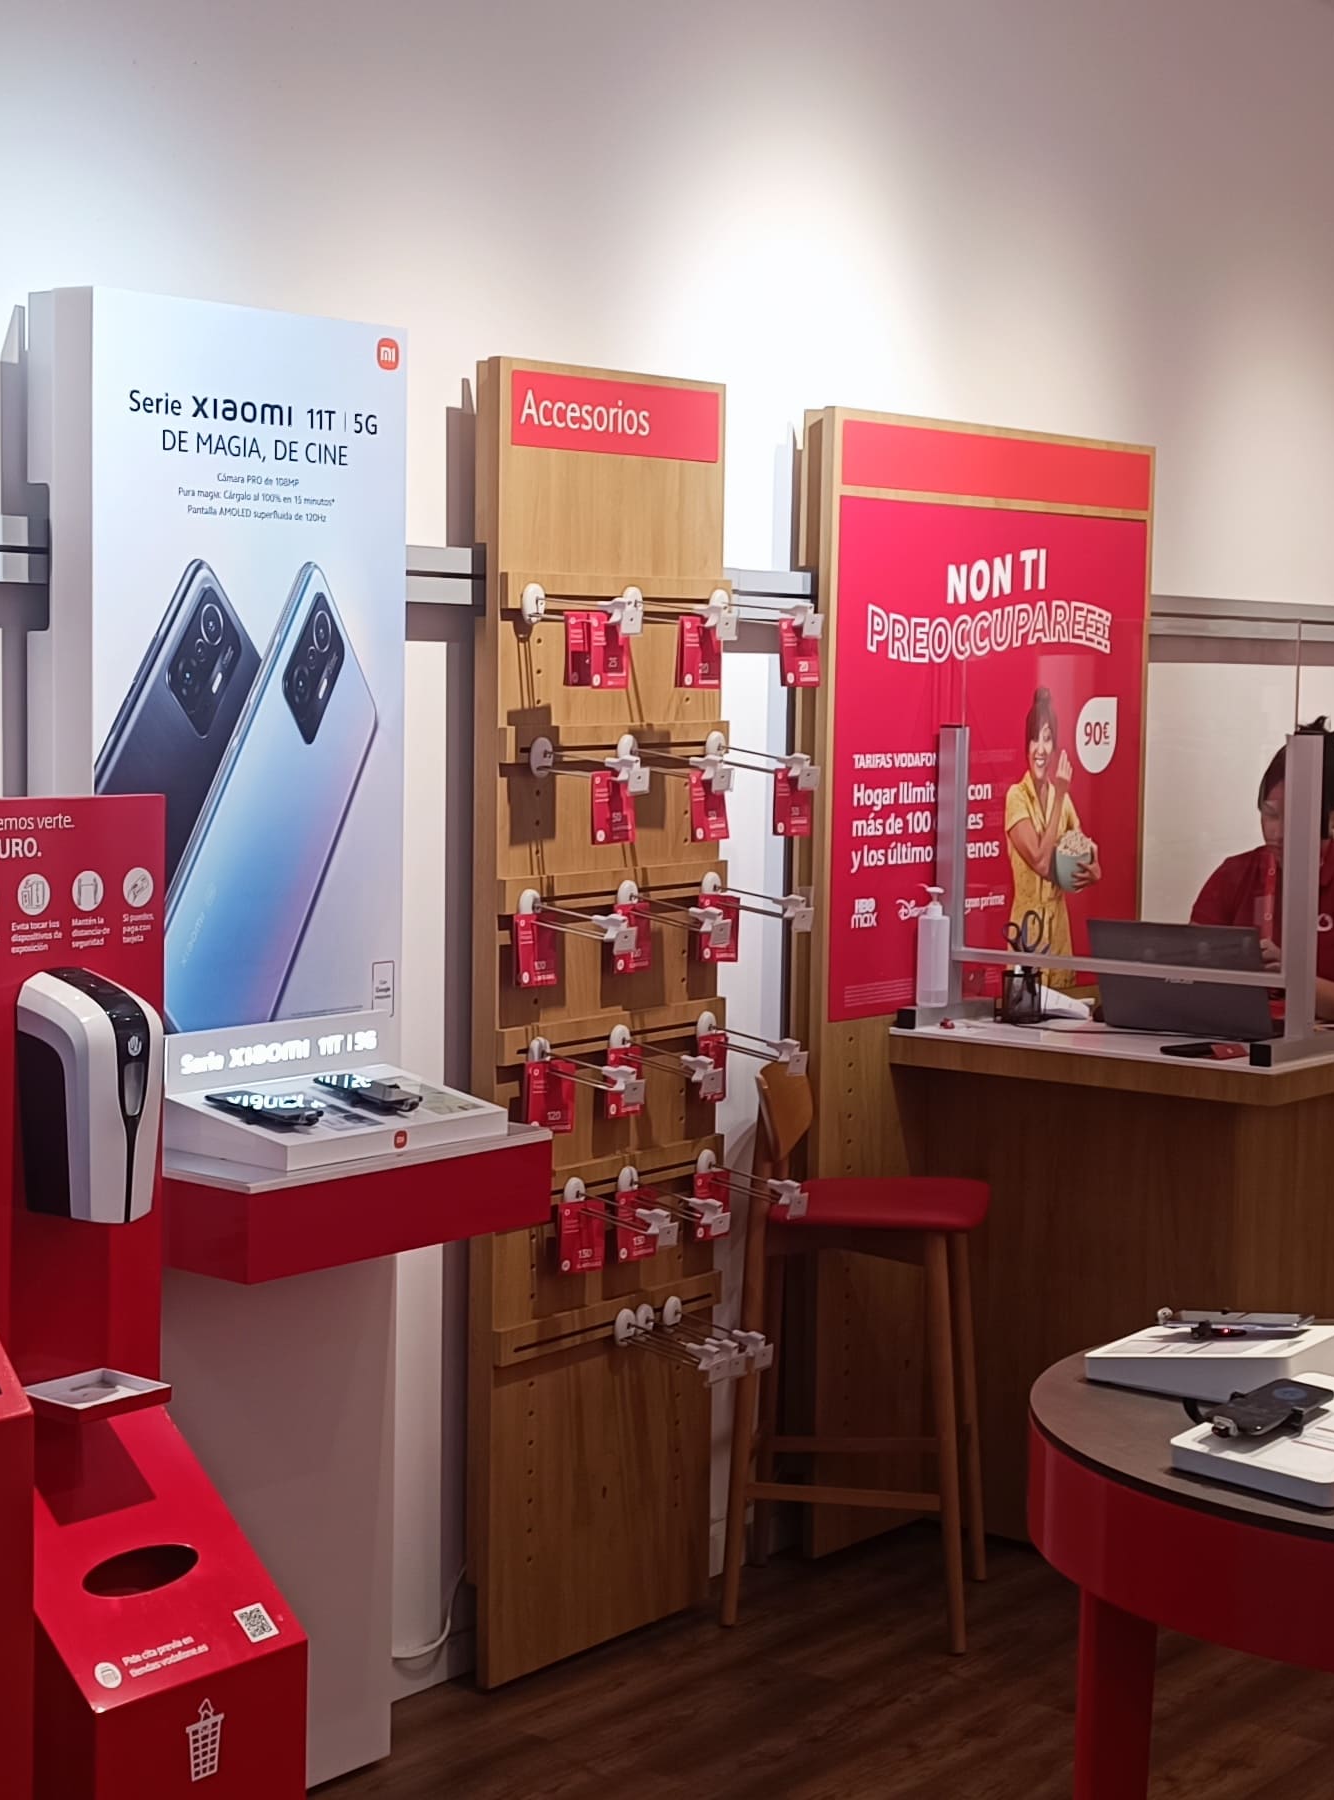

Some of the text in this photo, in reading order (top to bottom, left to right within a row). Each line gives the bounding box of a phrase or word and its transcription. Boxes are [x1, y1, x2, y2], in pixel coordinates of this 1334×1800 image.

[129, 389, 182, 415] Serie
[307, 408, 336, 432] 11T
[353, 413, 378, 435] 5G
[520, 389, 650, 436] Accesorios
[162, 429, 349, 466] DE MAGIA, DE CINE
[247, 475, 262, 485] PRO
[178, 487, 195, 497] Pura
[261, 493, 281, 503] 100%
[283, 496, 292, 504] en
[294, 495, 302, 505] 15
[187, 505, 217, 516] Pantalla
[218, 507, 252, 518] AMOLED
[294, 512, 303, 522] de
[305, 513, 327, 523] 120Hz
[946, 548, 1047, 604] NON TI
[1084, 721, 1110, 746] 90€
[852, 752, 937, 769] TARIFAS VODAFO
[852, 782, 992, 811] Hogar Ilimit con
[36, 813, 75, 829] verte.
[852, 814, 884, 837] más
[886, 813, 903, 835] de
[906, 811, 932, 834] 100
[851, 838, 1000, 874] y los último enos
[981, 893, 1005, 909] prime
[180, 1051, 224, 1076] Serie
[182, 1636, 195, 1645] en
